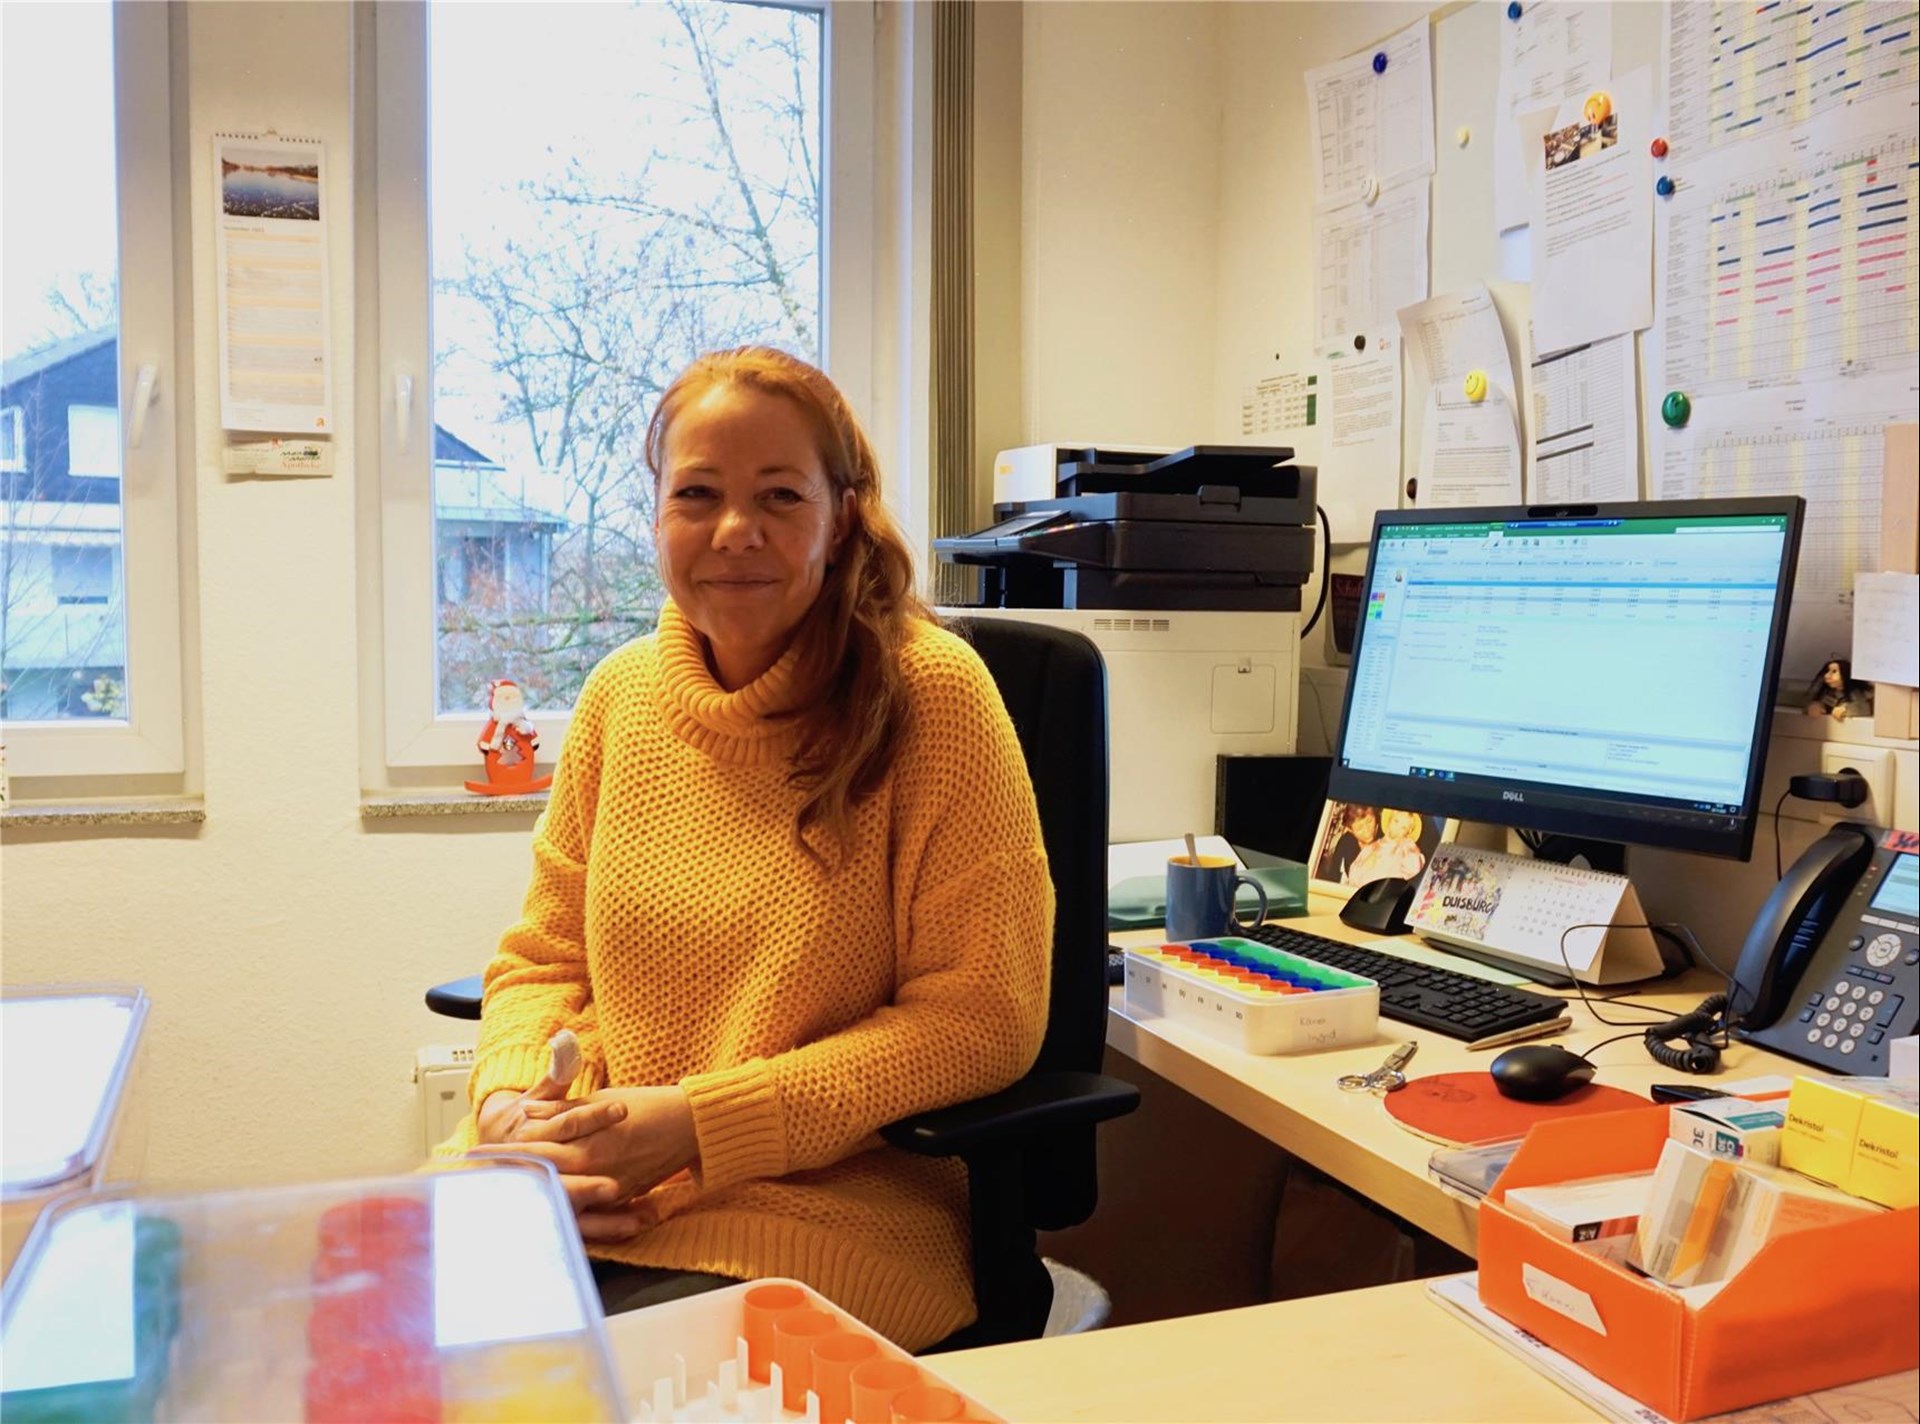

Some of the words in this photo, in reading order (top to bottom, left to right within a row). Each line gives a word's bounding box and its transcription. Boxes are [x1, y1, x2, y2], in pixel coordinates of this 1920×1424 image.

[1503, 791, 1524, 802] DELL
[1442, 896, 1493, 914] DUISBURG
[1788, 1113, 1825, 1132] Dekristol
[1859, 1138, 1899, 1159] Dekristol
